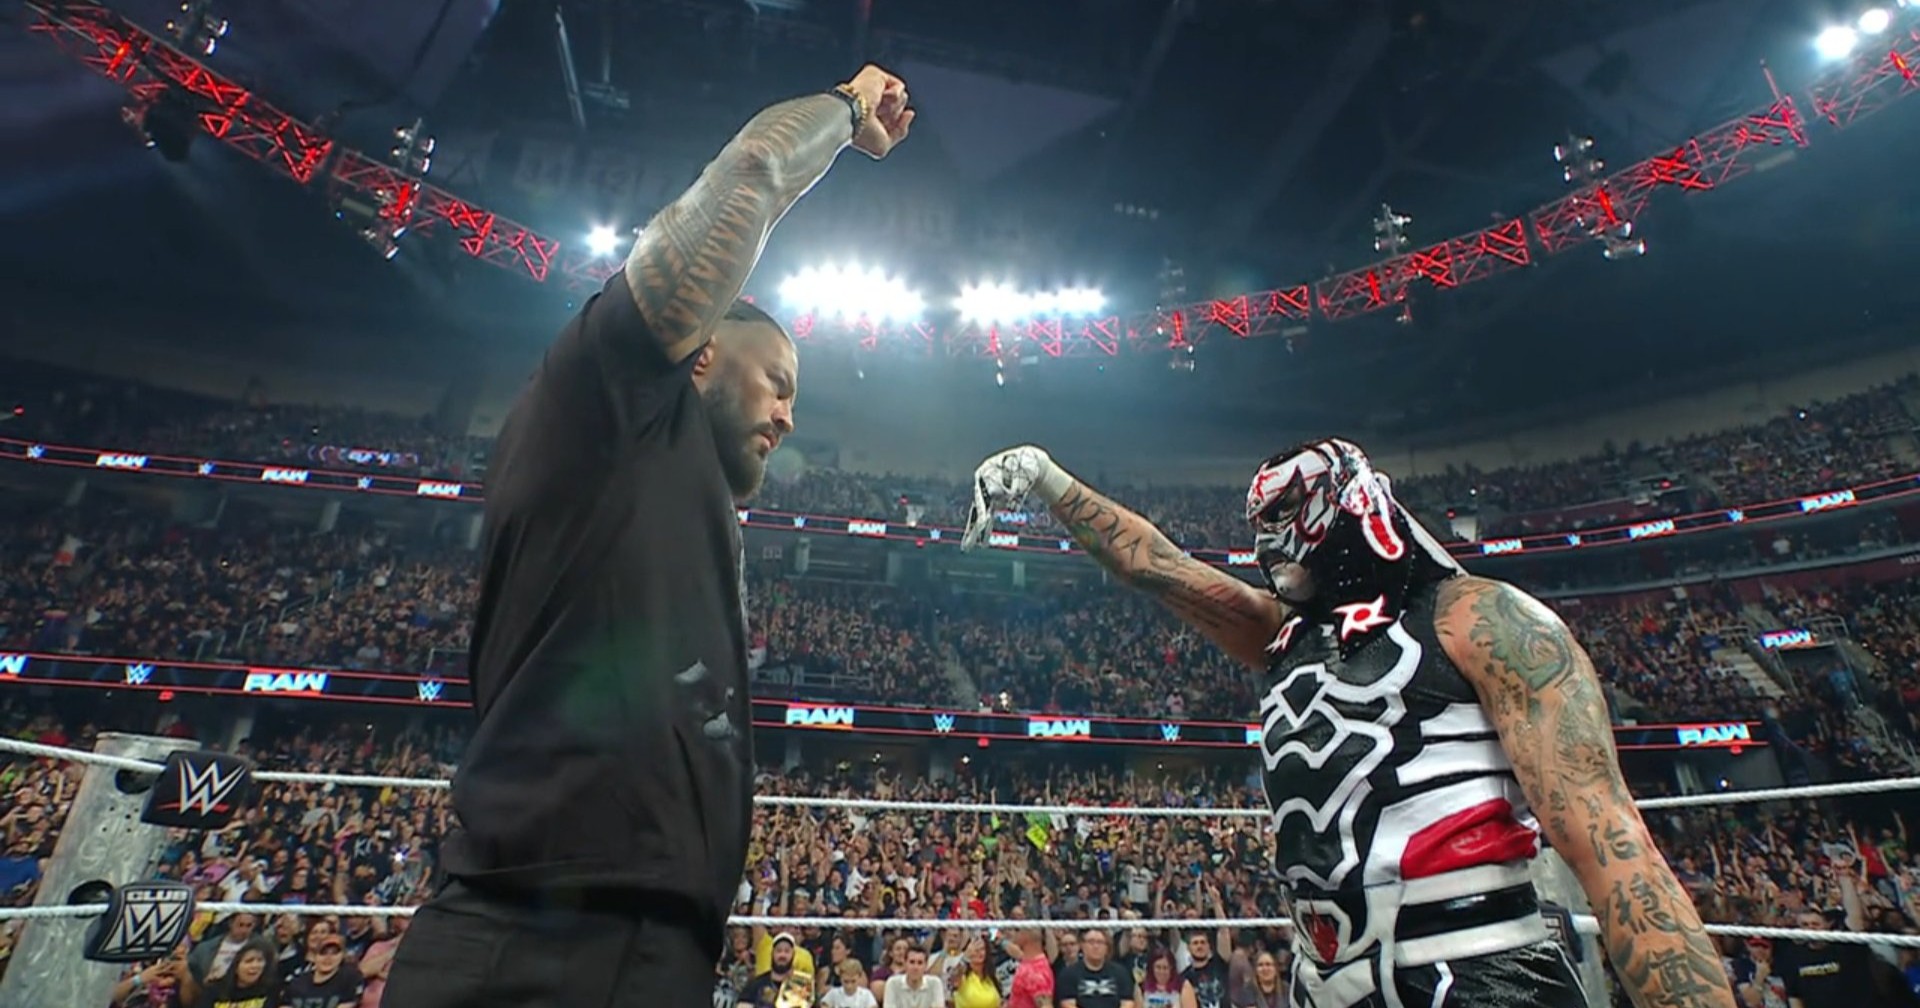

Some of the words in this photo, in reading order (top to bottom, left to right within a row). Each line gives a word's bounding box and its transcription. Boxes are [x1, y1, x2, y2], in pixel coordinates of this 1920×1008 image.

[96, 455, 148, 467] RAW
[261, 468, 308, 483] RAW
[416, 483, 461, 497] RAW
[848, 522, 886, 535] RAW
[1483, 539, 1523, 555] RAW
[1628, 519, 1675, 539] RAW
[1801, 490, 1855, 512] RAW
[1762, 629, 1811, 649] RAW
[243, 673, 328, 692] RAW
[785, 707, 855, 725] RAW
[1028, 720, 1091, 737] RAW
[1677, 723, 1750, 746] RAW
[126, 889, 189, 902] CLUB
